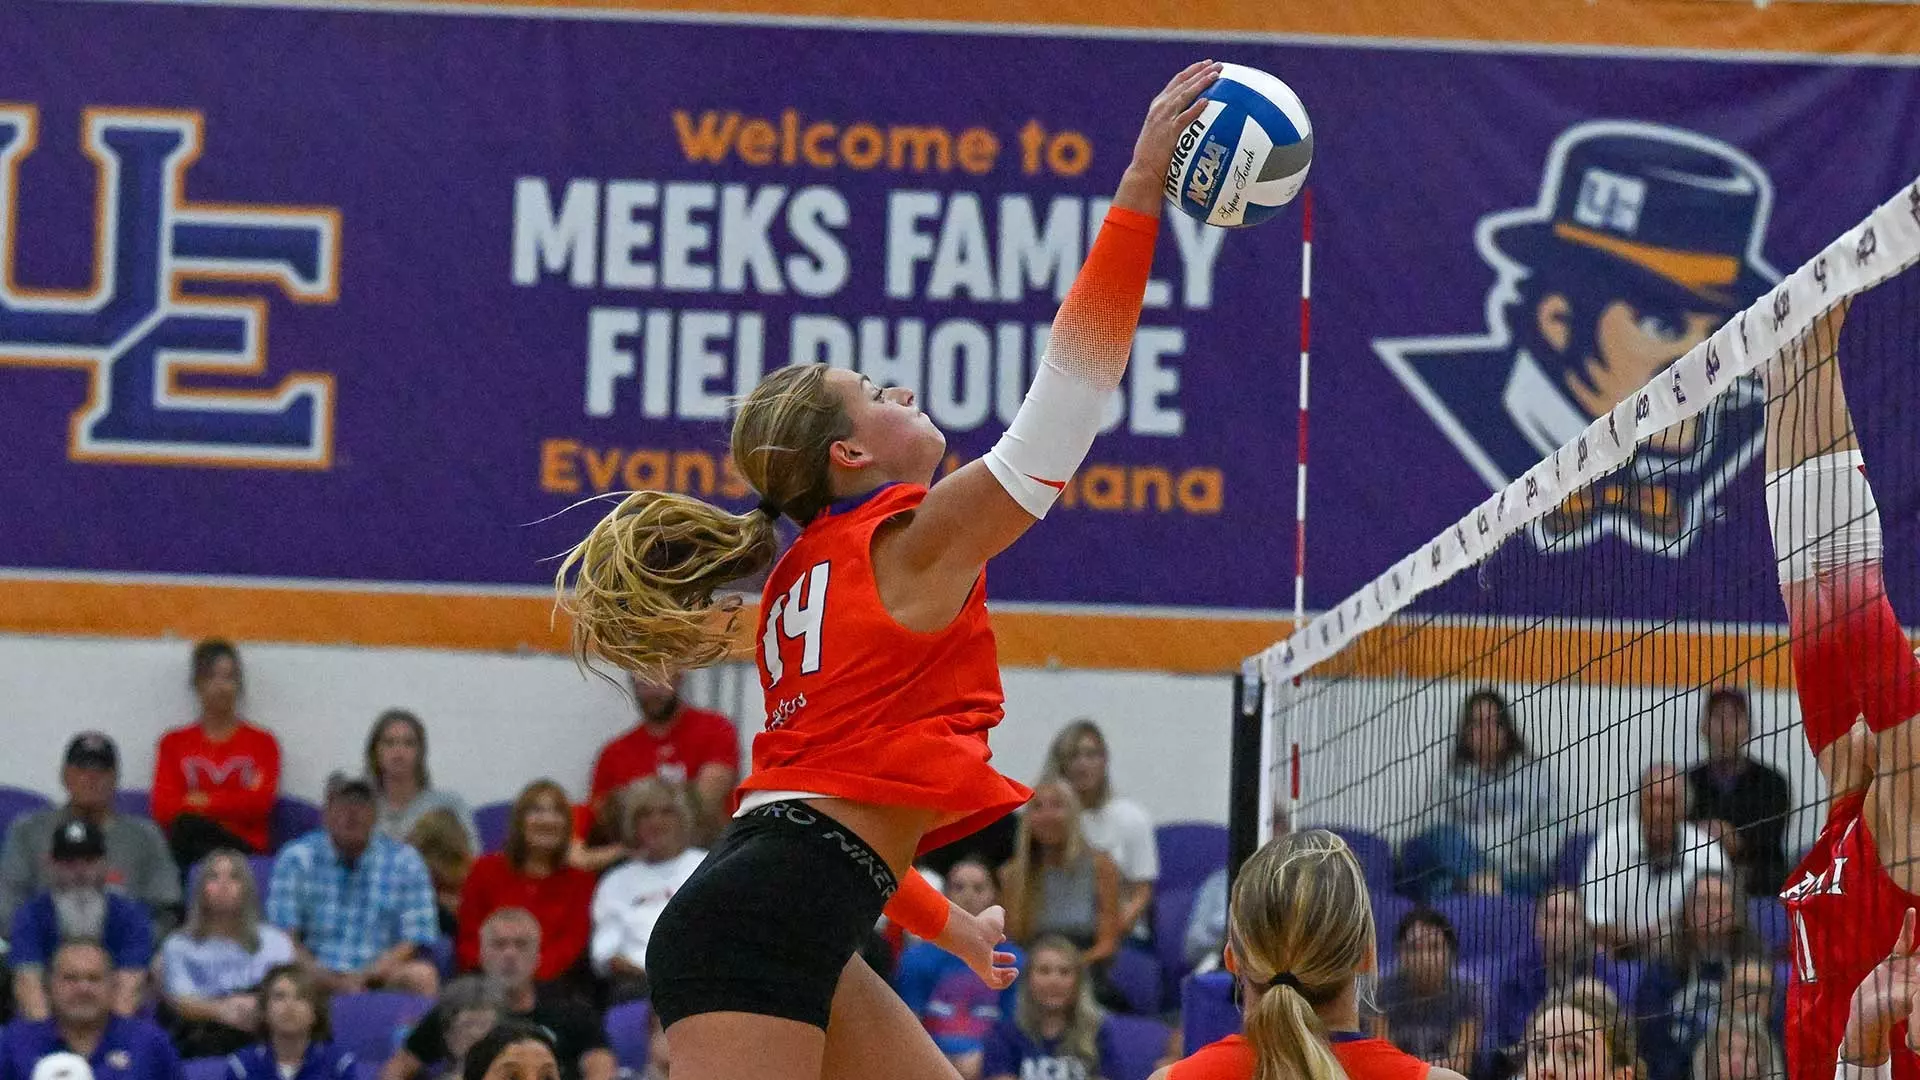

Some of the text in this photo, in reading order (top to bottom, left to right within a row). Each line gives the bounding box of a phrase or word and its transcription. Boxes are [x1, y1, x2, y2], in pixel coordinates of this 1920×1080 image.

[673, 107, 1092, 176] Welcome to
[1165, 119, 1206, 199] molten
[1187, 140, 1230, 206] NCAA
[1218, 192, 1241, 220] Super
[1234, 148, 1255, 190] Touch
[512, 176, 1225, 310] MEEKS FAMY
[585, 307, 1186, 437] FIELDHOUE
[763, 560, 831, 690] 14
